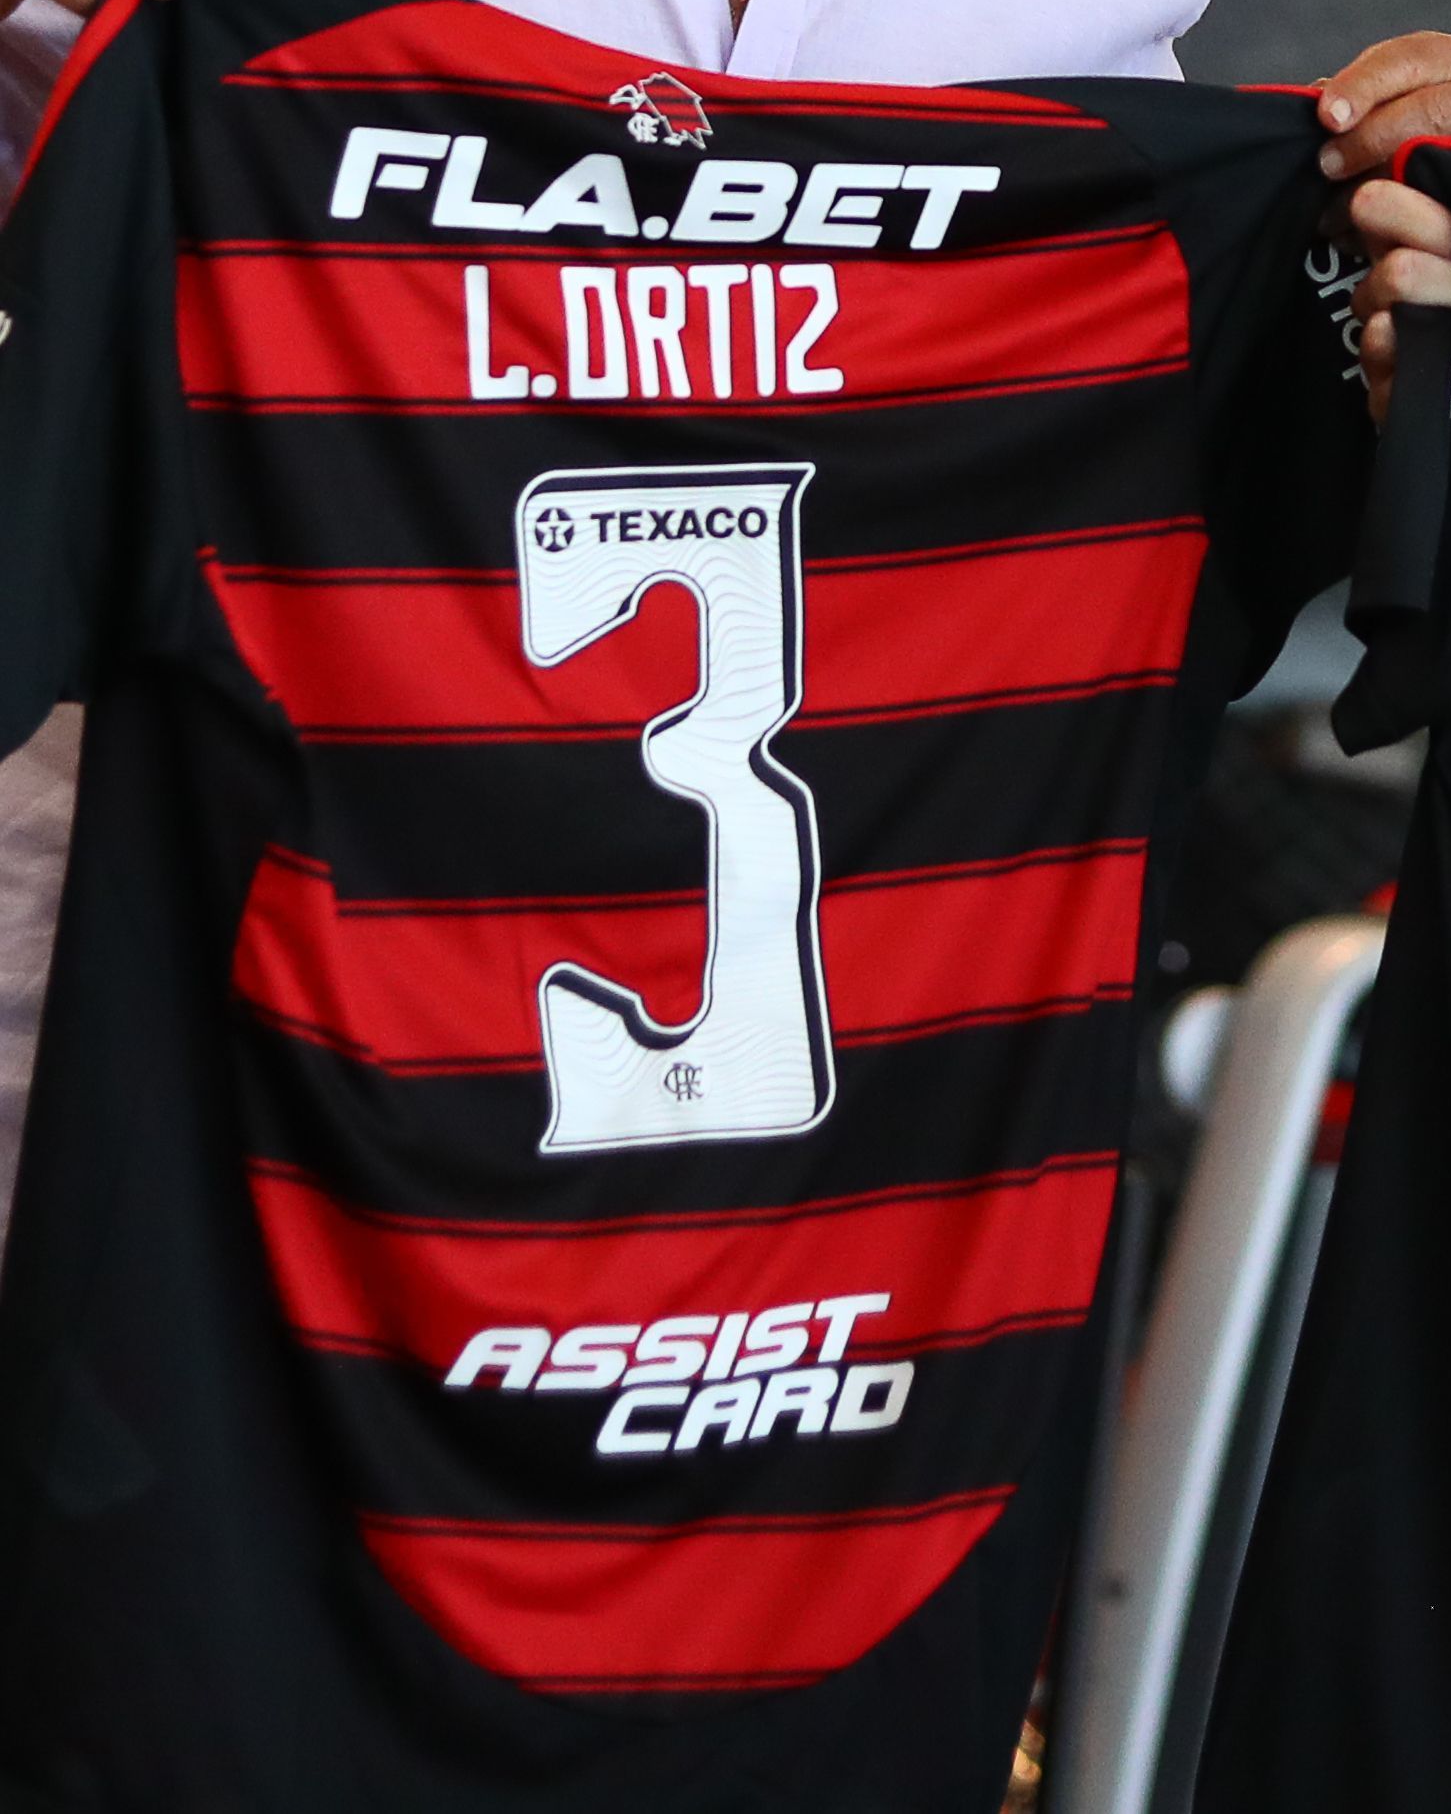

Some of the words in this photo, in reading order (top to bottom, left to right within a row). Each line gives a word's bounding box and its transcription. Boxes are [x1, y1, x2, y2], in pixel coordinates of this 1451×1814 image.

[329, 126, 1001, 251] FLA.BET
[463, 262, 845, 401] L.ORTIZ
[589, 507, 769, 545] TEXACO
[515, 460, 837, 1155] 3
[443, 1291, 892, 1391] ASSIST
[595, 1360, 916, 1455] CARD
